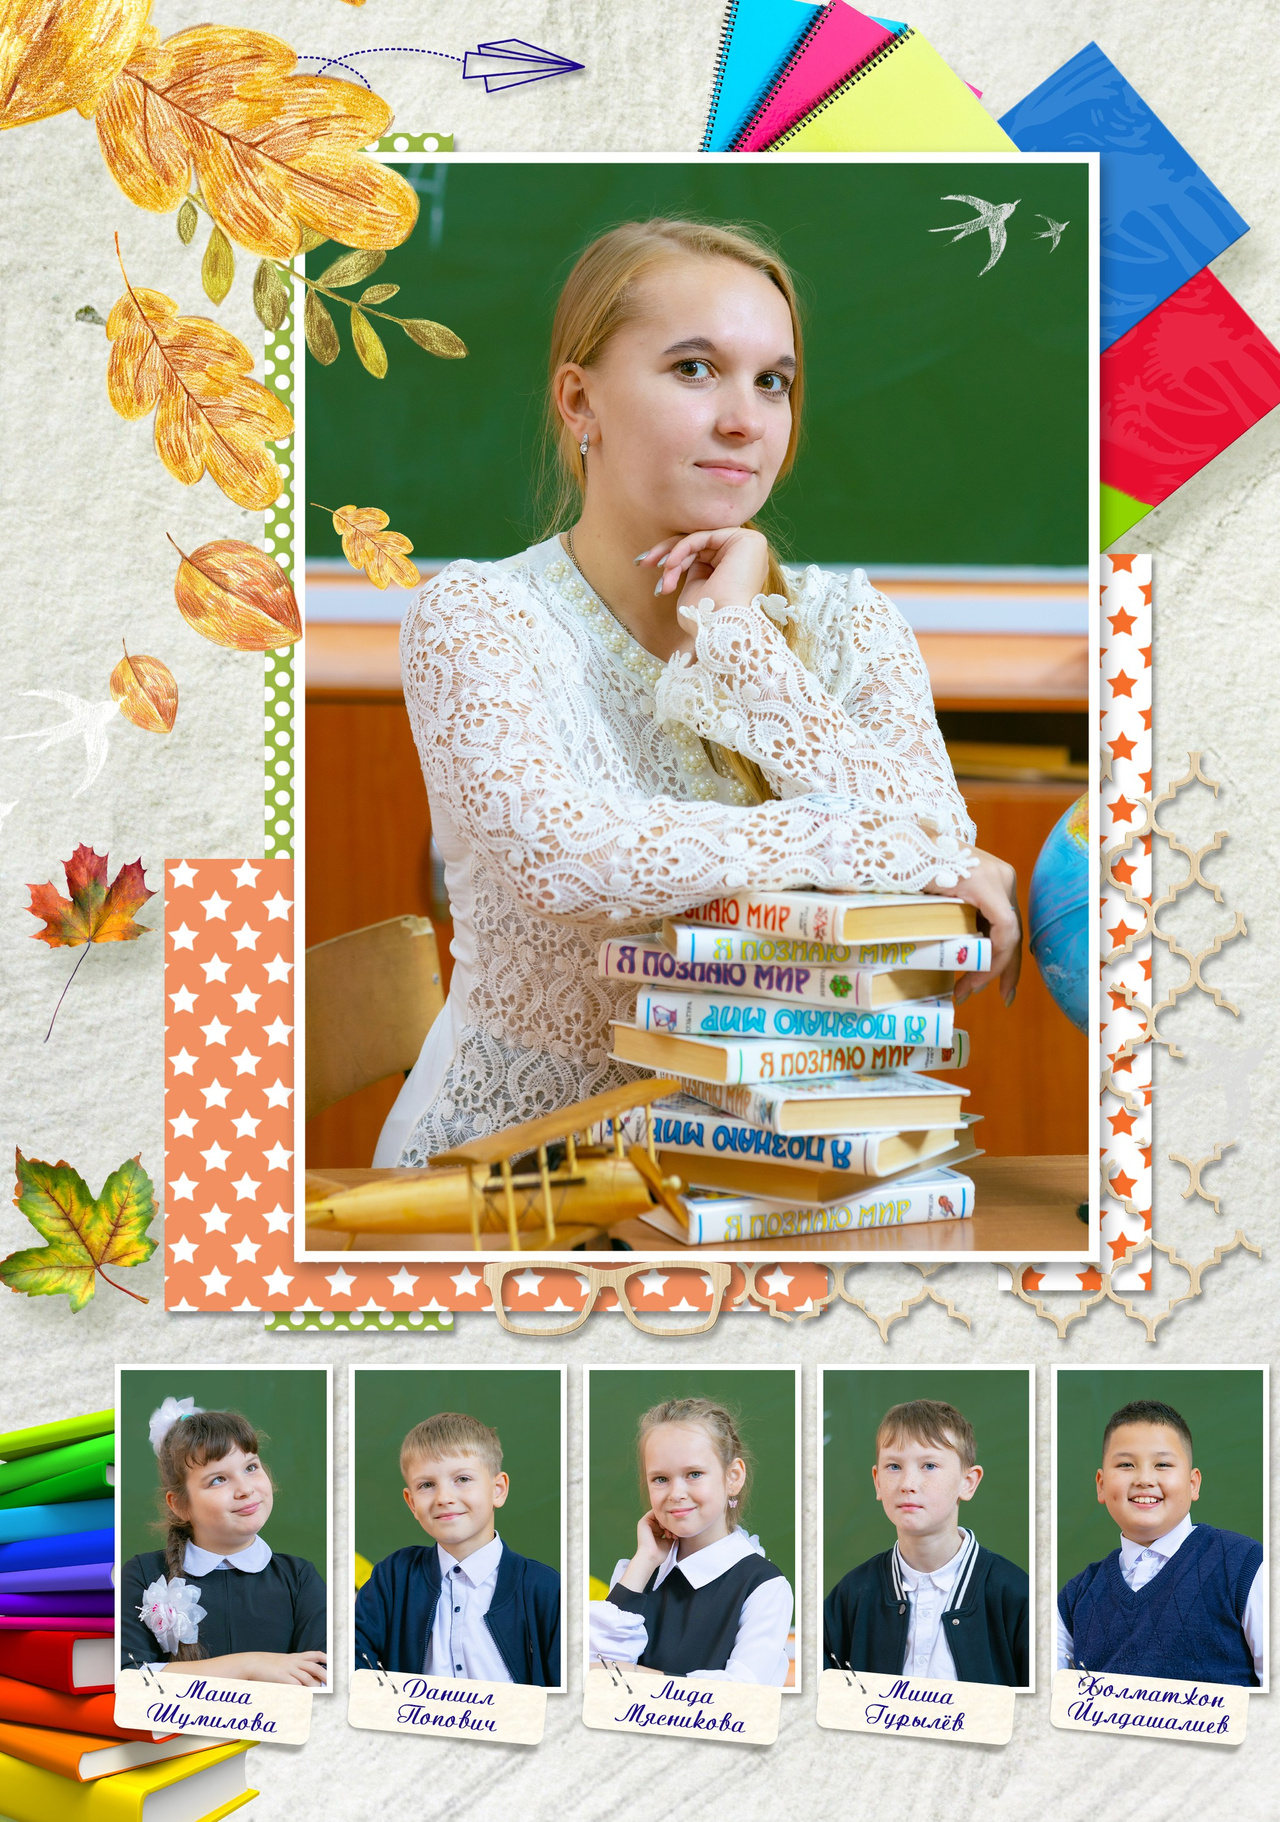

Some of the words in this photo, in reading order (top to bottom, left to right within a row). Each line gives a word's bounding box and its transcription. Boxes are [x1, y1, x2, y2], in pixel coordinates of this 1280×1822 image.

[747, 902, 791, 932] МИР
[713, 937, 733, 961] Я
[740, 940, 851, 963] ПОЗНАЮ
[858, 942, 917, 966] МИР
[616, 945, 639, 975] Я
[642, 950, 747, 987] ПОЗНАЮ
[753, 964, 811, 995] МИР
[700, 1004, 767, 1035] МИР
[773, 1008, 897, 1041] ПОЗНАЮ
[903, 1014, 925, 1045] Я
[759, 1051, 775, 1079] Я
[780, 1047, 866, 1076] ПОЗНАЮ
[871, 1045, 916, 1070] МИР
[712, 1124, 826, 1163] ПОЗНАЮ
[831, 1139, 852, 1170] Я
[724, 1213, 743, 1242] Я
[750, 1205, 853, 1239] ПОЗНАЮ
[858, 1198, 913, 1228] МИР
